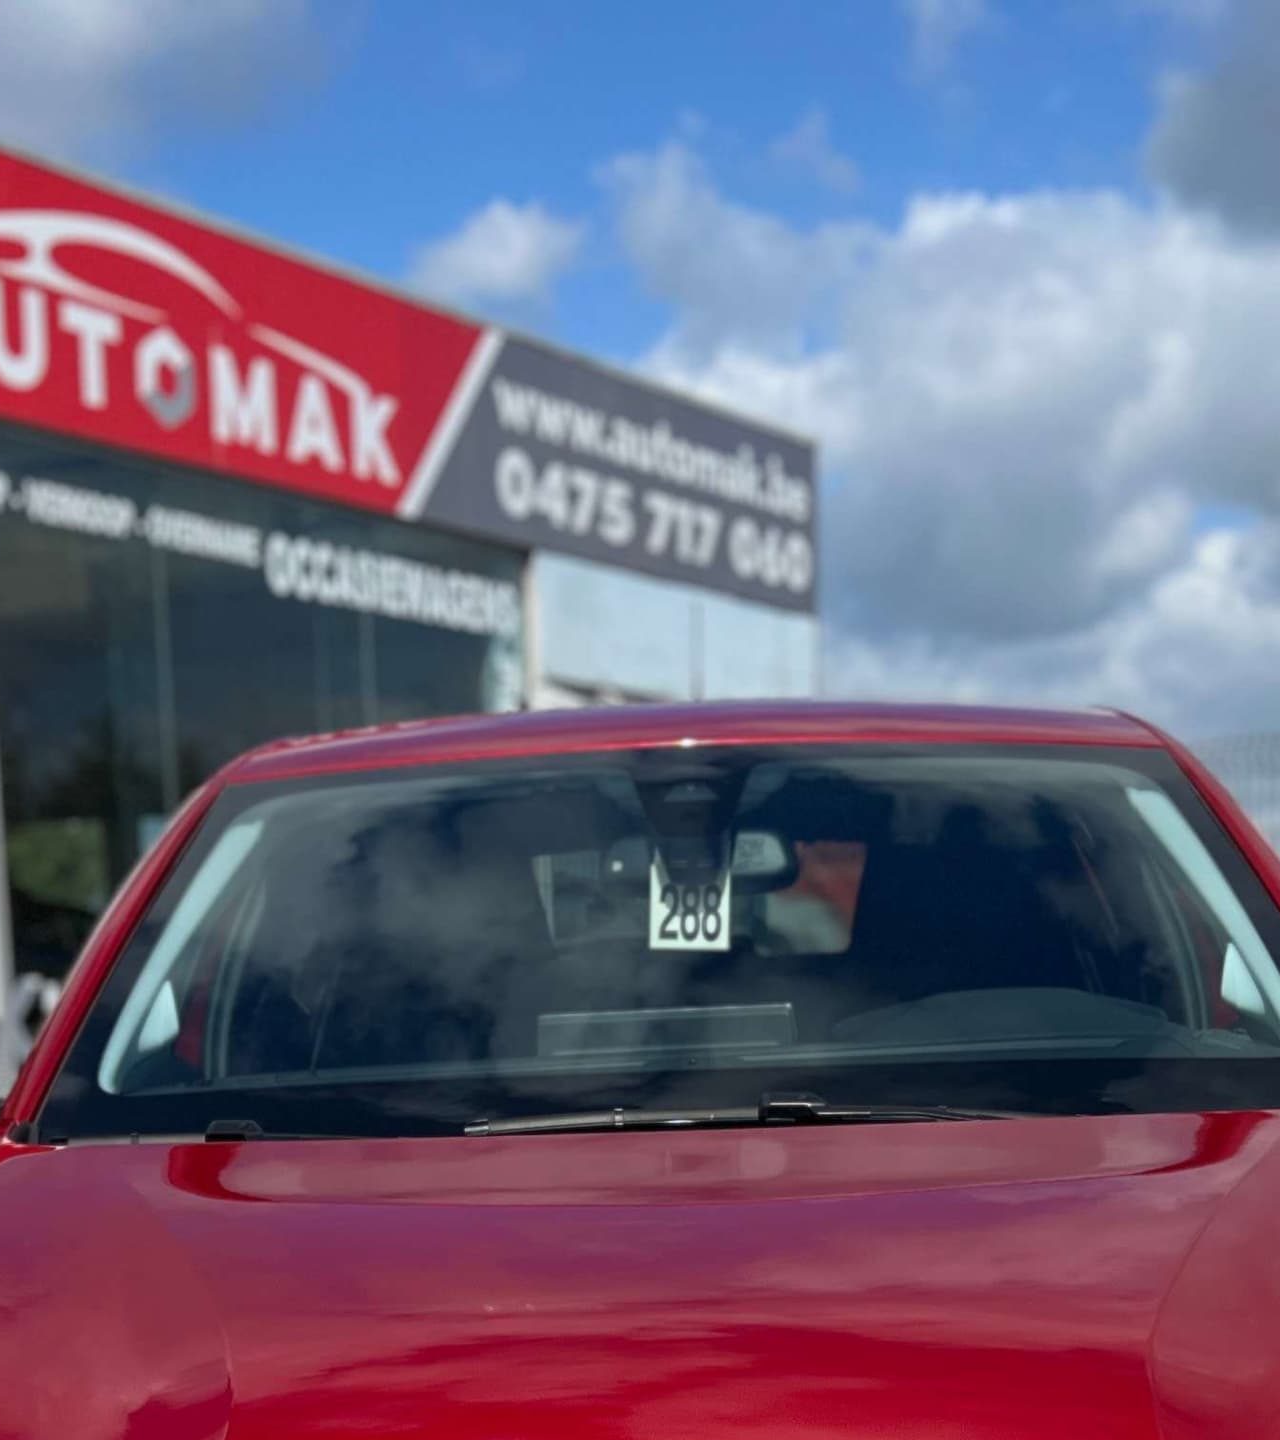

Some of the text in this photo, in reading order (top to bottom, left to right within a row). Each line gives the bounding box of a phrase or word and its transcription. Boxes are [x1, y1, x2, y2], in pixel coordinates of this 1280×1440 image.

[491, 376, 811, 524] www.automak.be
[494, 446, 814, 594] 0475 717 060
[658, 884, 722, 942] 288
